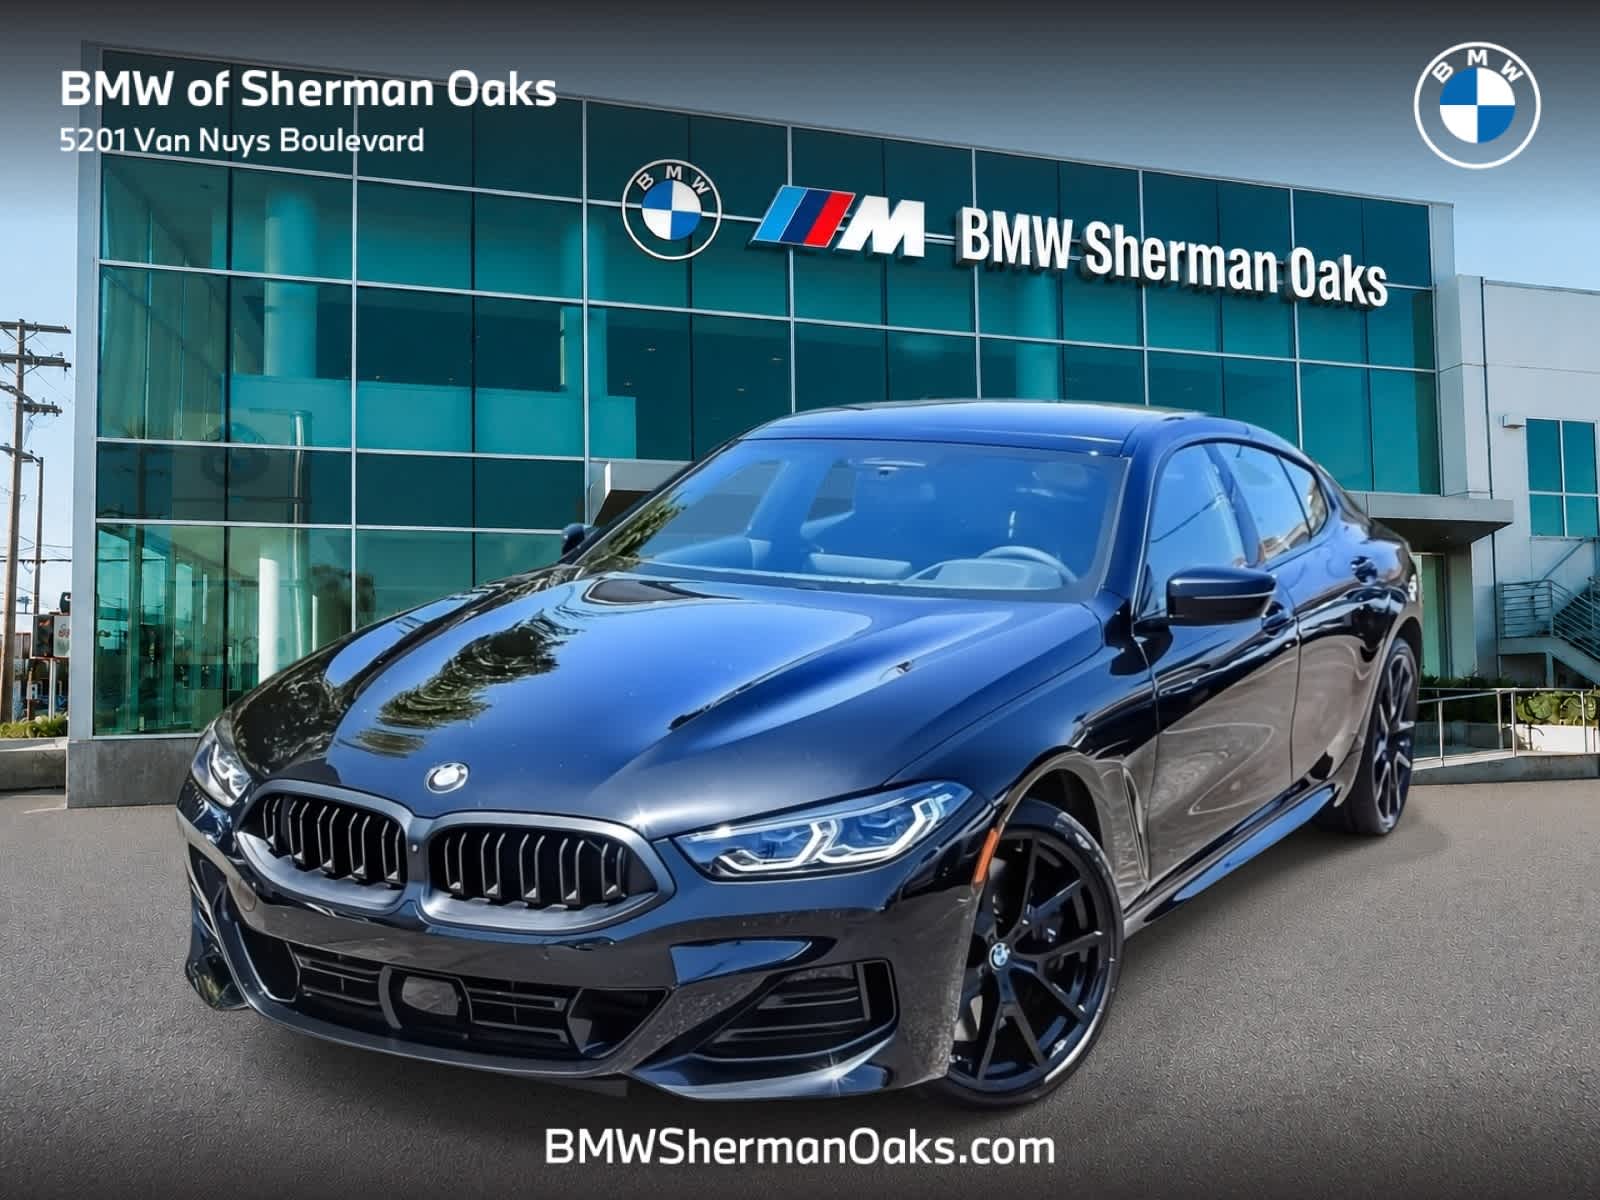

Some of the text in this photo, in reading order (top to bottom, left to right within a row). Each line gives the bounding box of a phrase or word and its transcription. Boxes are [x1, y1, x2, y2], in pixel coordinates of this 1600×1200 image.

[636, 165, 711, 195] BMW
[834, 195, 925, 257] M
[958, 206, 1388, 307] BMW Sherman Oaks
